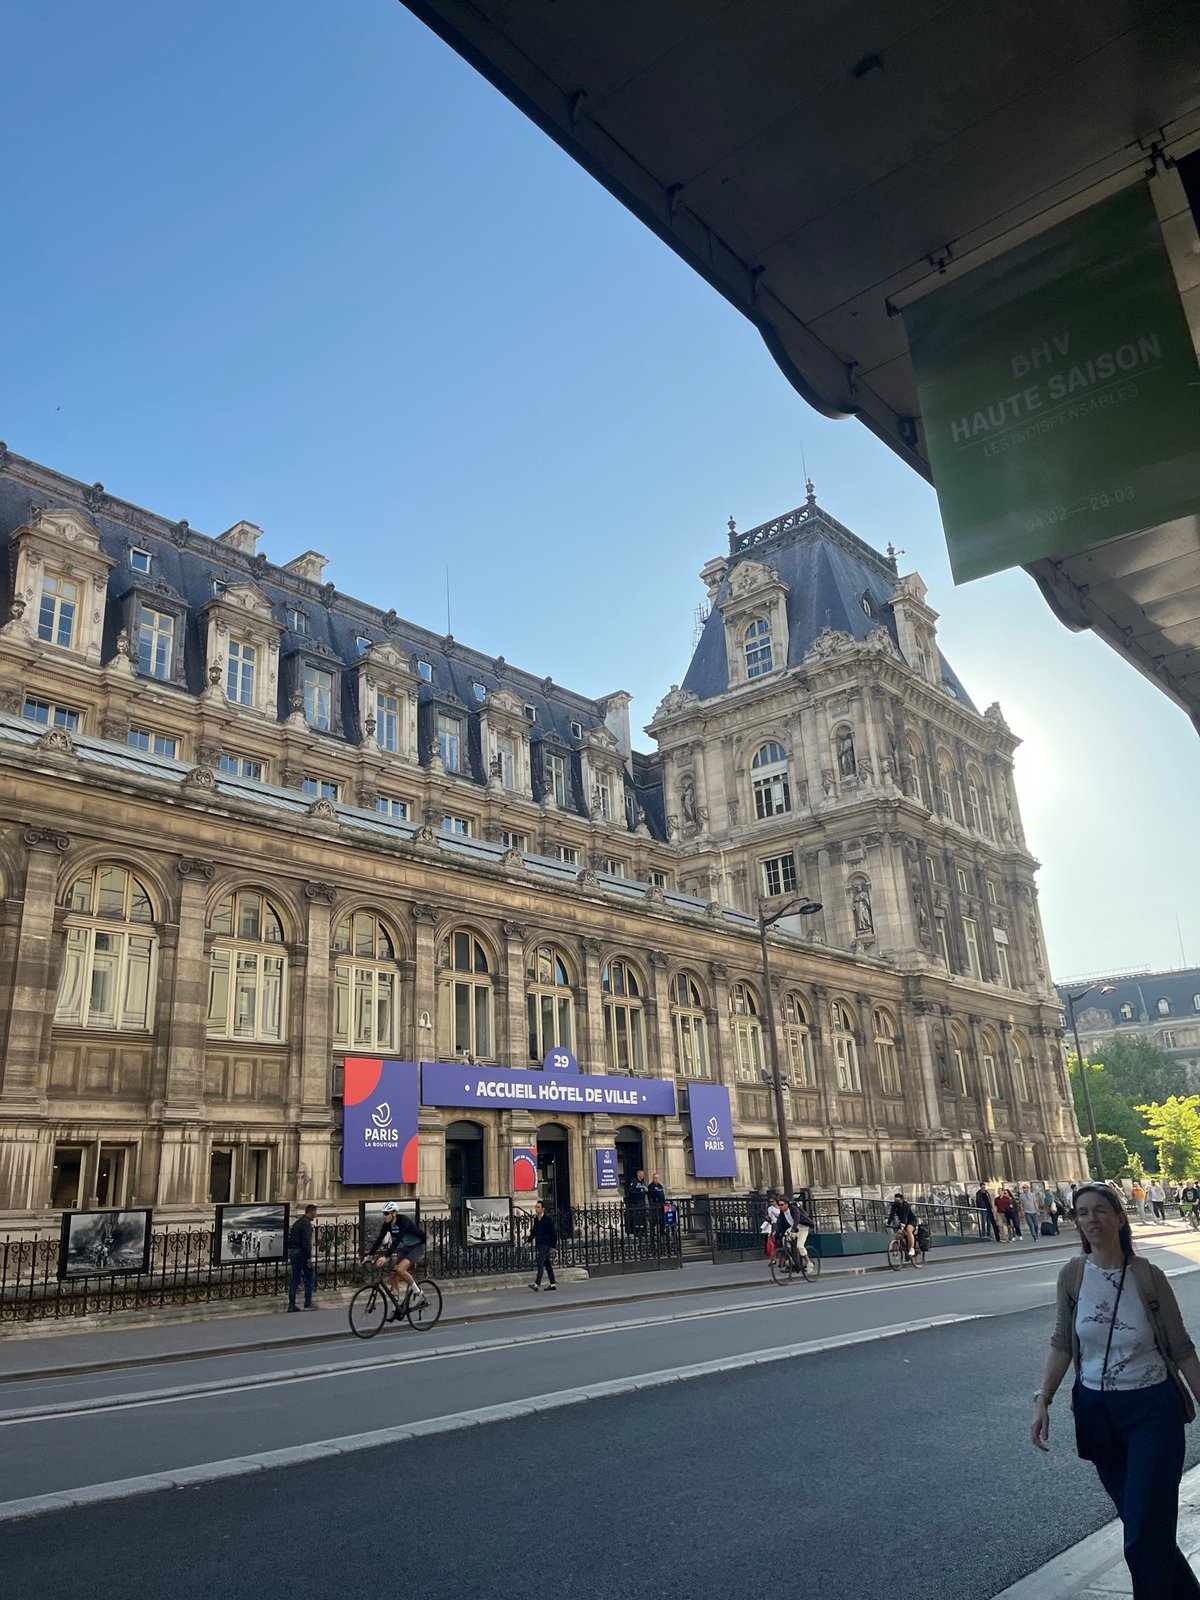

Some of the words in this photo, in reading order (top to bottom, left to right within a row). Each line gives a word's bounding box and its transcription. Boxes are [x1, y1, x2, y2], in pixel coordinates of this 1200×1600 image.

[1010, 331, 1072, 378] BHV
[951, 385, 1043, 443] HAUTE
[1048, 333, 1163, 400] SAISON
[983, 439, 1010, 458] LES
[1011, 383, 1139, 446] INDISPENSABLES
[553, 1054, 570, 1068] 29
[476, 1081, 537, 1099] ACCUEIL
[539, 1081, 584, 1102] HÔTEL
[585, 1088, 603, 1103] DE
[604, 1089, 638, 1105] VILLE
[364, 1128, 399, 1141] PARIS
[704, 1140, 725, 1151] PARIS
